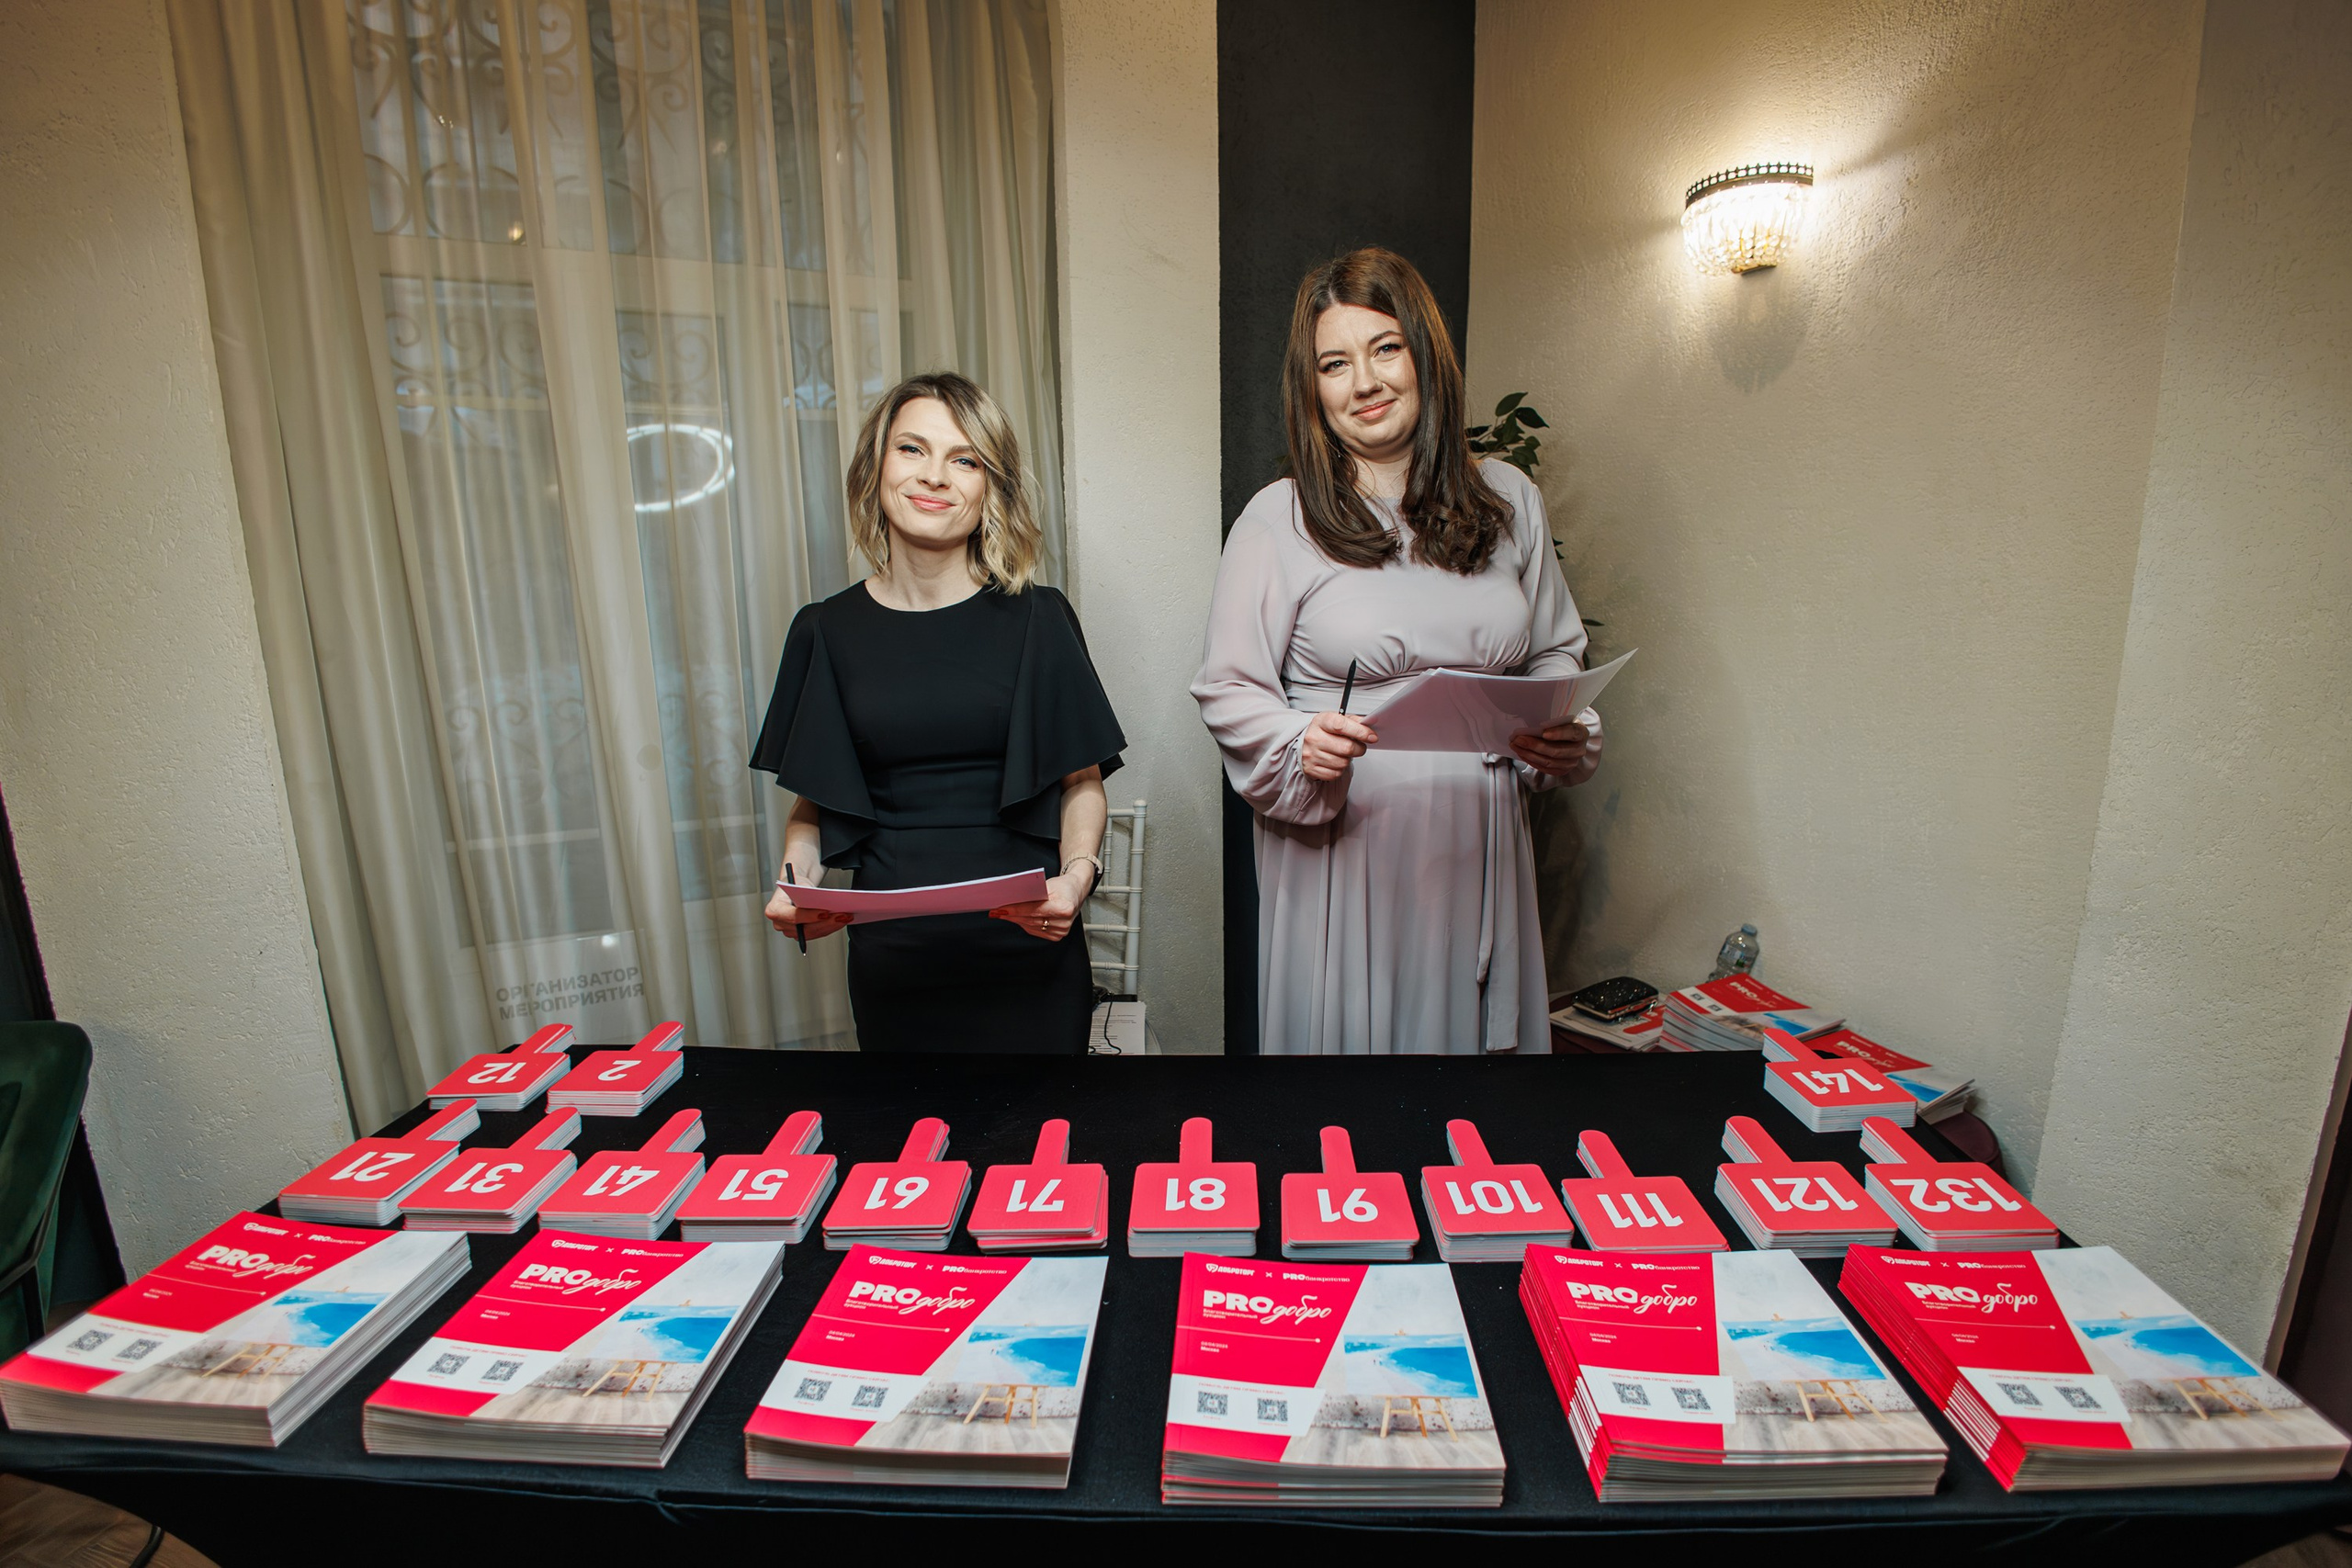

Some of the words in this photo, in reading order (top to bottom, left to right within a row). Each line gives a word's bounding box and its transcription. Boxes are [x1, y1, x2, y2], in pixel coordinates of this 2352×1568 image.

[496, 966, 639, 1002] ОРГАНИЗАТОР
[499, 983, 644, 1021] МЕРОПРИЯТИЯ
[468, 1062, 526, 1084] 12
[598, 1060, 641, 1080] 2
[1792, 1068, 1884, 1095] 141
[330, 1152, 415, 1182] 21
[445, 1162, 525, 1193] 31
[582, 1166, 660, 1196] 41
[718, 1169, 789, 1200] 51
[864, 1177, 929, 1210] 61
[1006, 1179, 1065, 1212] 71
[1165, 1178, 1226, 1212] 81
[1445, 1180, 1544, 1214] 101
[1750, 1178, 1859, 1213] 121
[1890, 1178, 2023, 1213] 132
[1317, 1188, 1379, 1223] 91
[1597, 1192, 1682, 1228] 111
